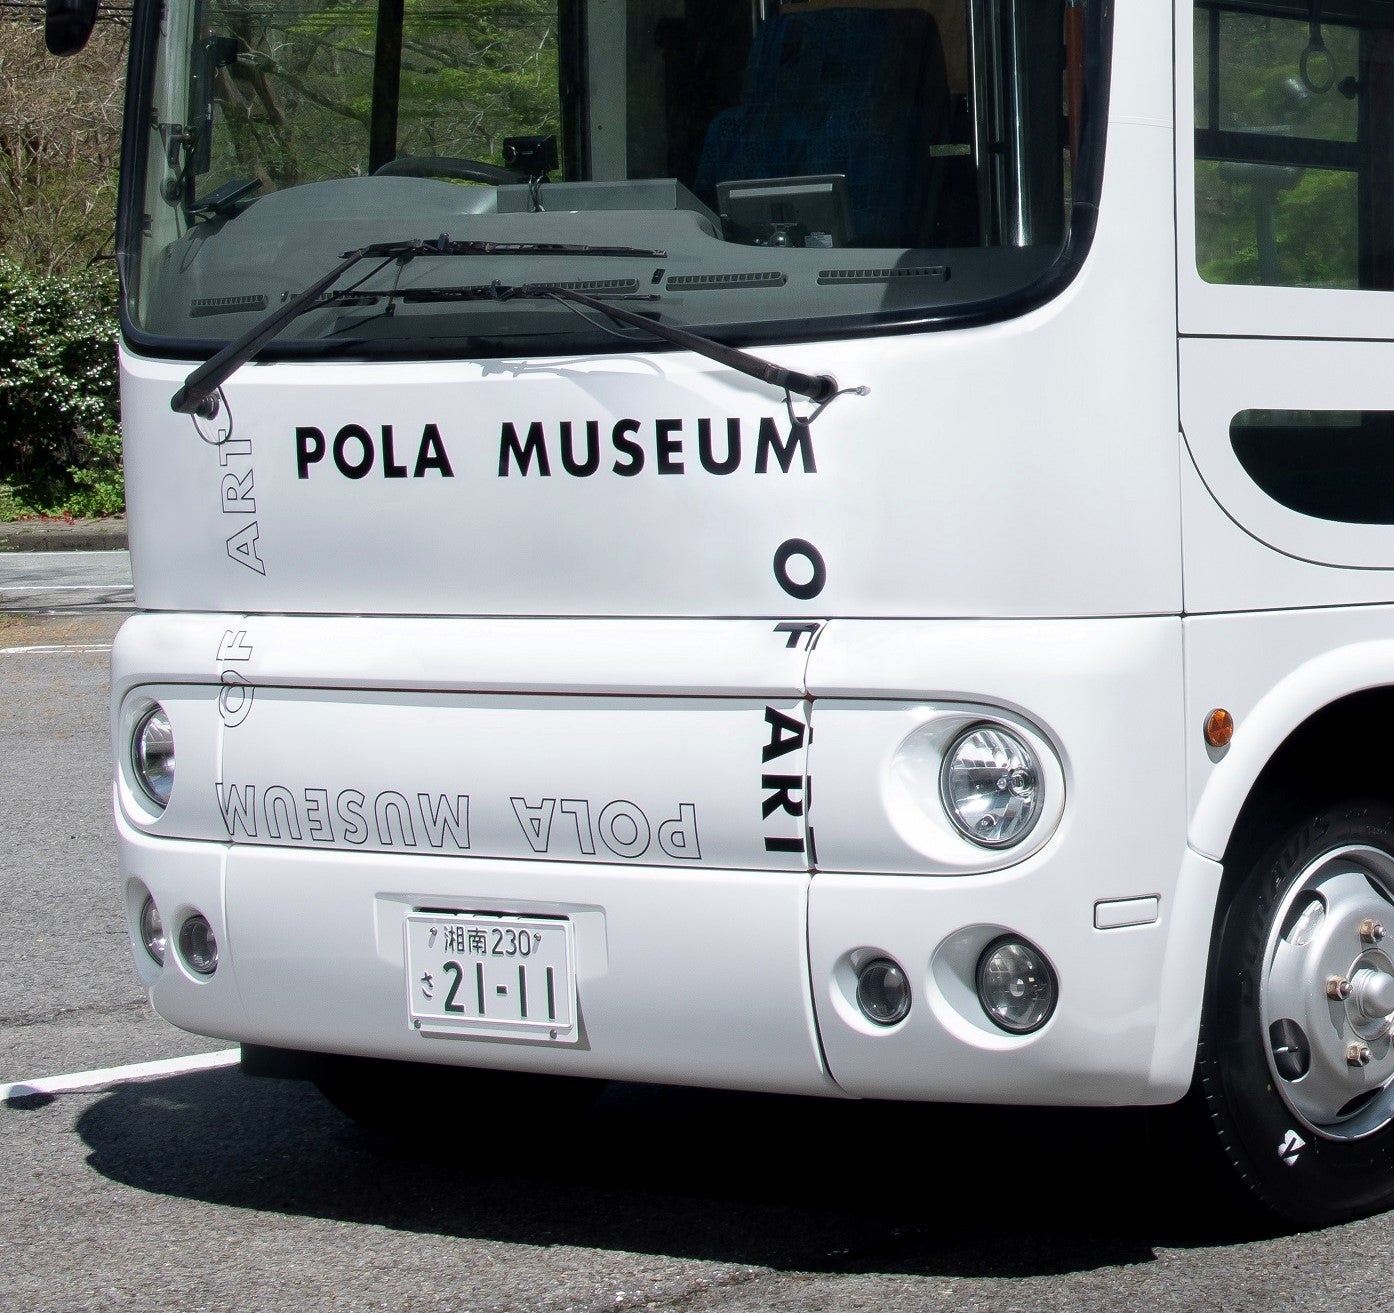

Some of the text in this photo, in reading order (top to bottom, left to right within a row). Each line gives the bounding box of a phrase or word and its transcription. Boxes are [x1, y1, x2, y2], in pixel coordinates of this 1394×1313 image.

[295, 415, 818, 479] POLA MUSEUM
[215, 428, 267, 728] OF ART
[772, 537, 827, 653] OF
[214, 781, 702, 861] POLA MUSEUM
[420, 960, 556, 1020] さ 21-11
